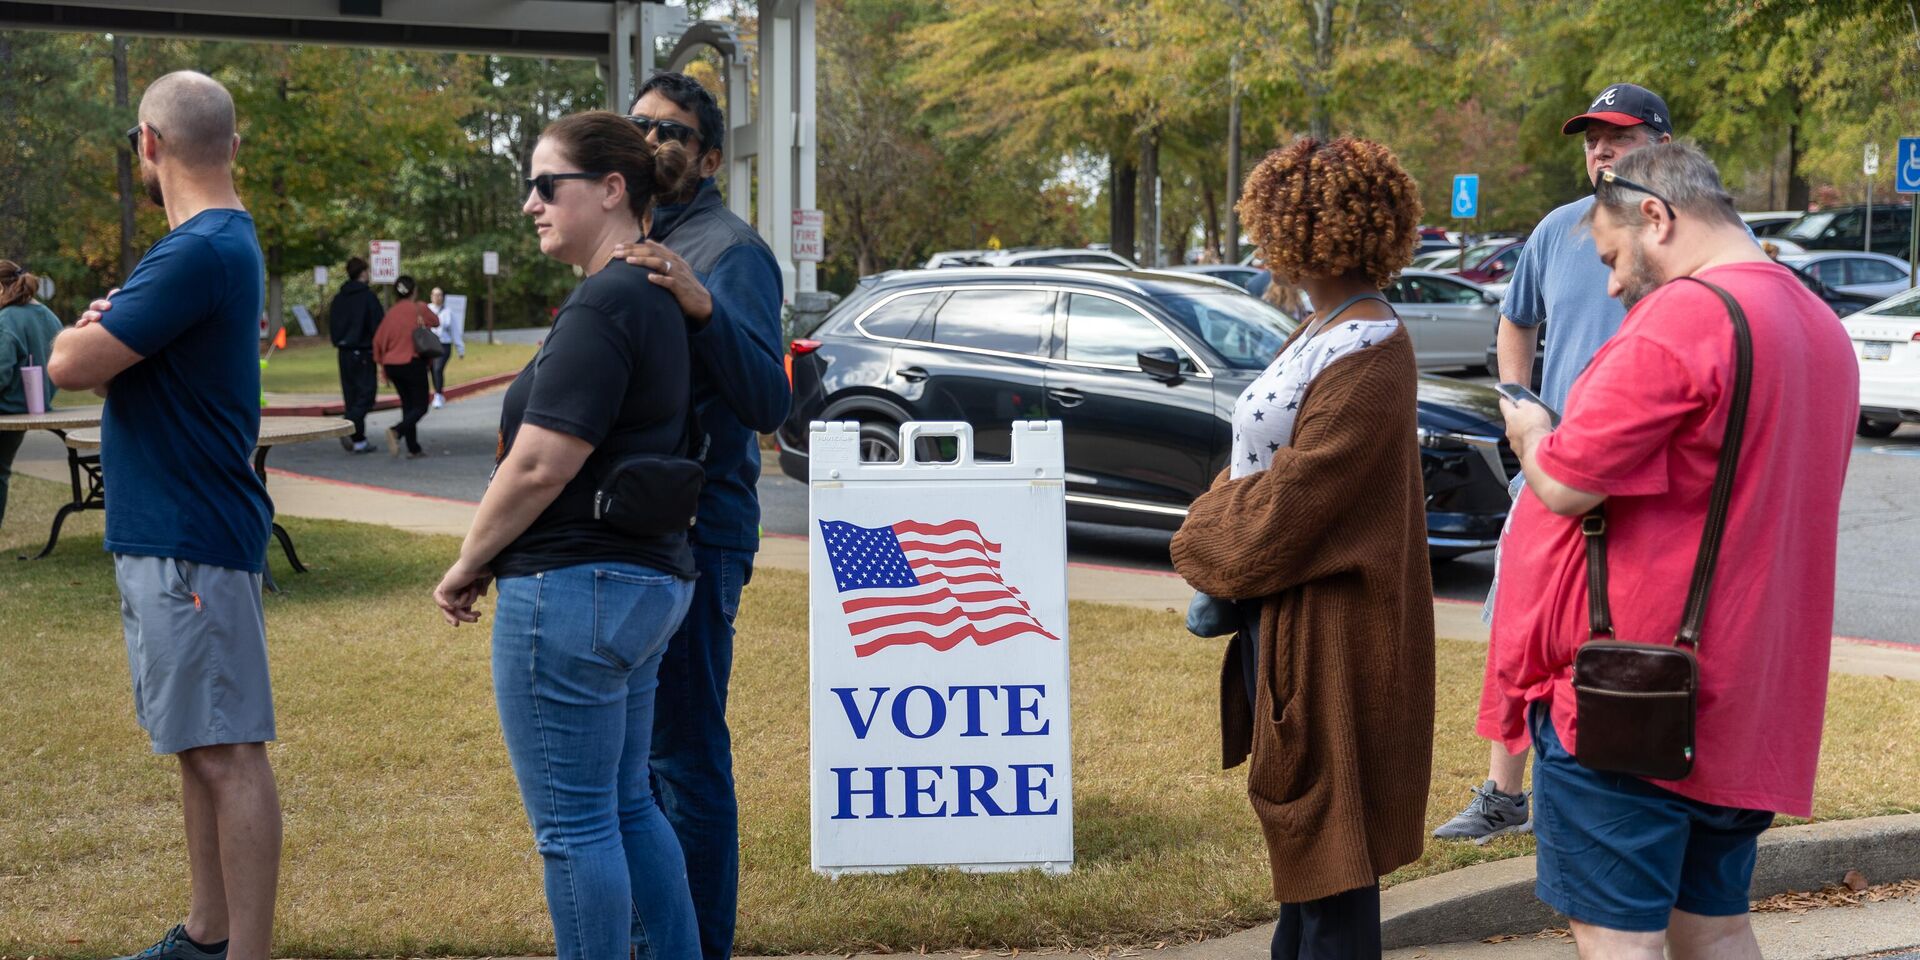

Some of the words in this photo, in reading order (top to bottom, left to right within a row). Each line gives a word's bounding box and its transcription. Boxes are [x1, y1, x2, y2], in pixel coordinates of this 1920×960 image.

[1591, 88, 1618, 106] A
[796, 229, 817, 241] FIRE
[793, 243, 818, 255] LANE
[830, 684, 1050, 740] VOTE
[830, 763, 1058, 820] HERE
